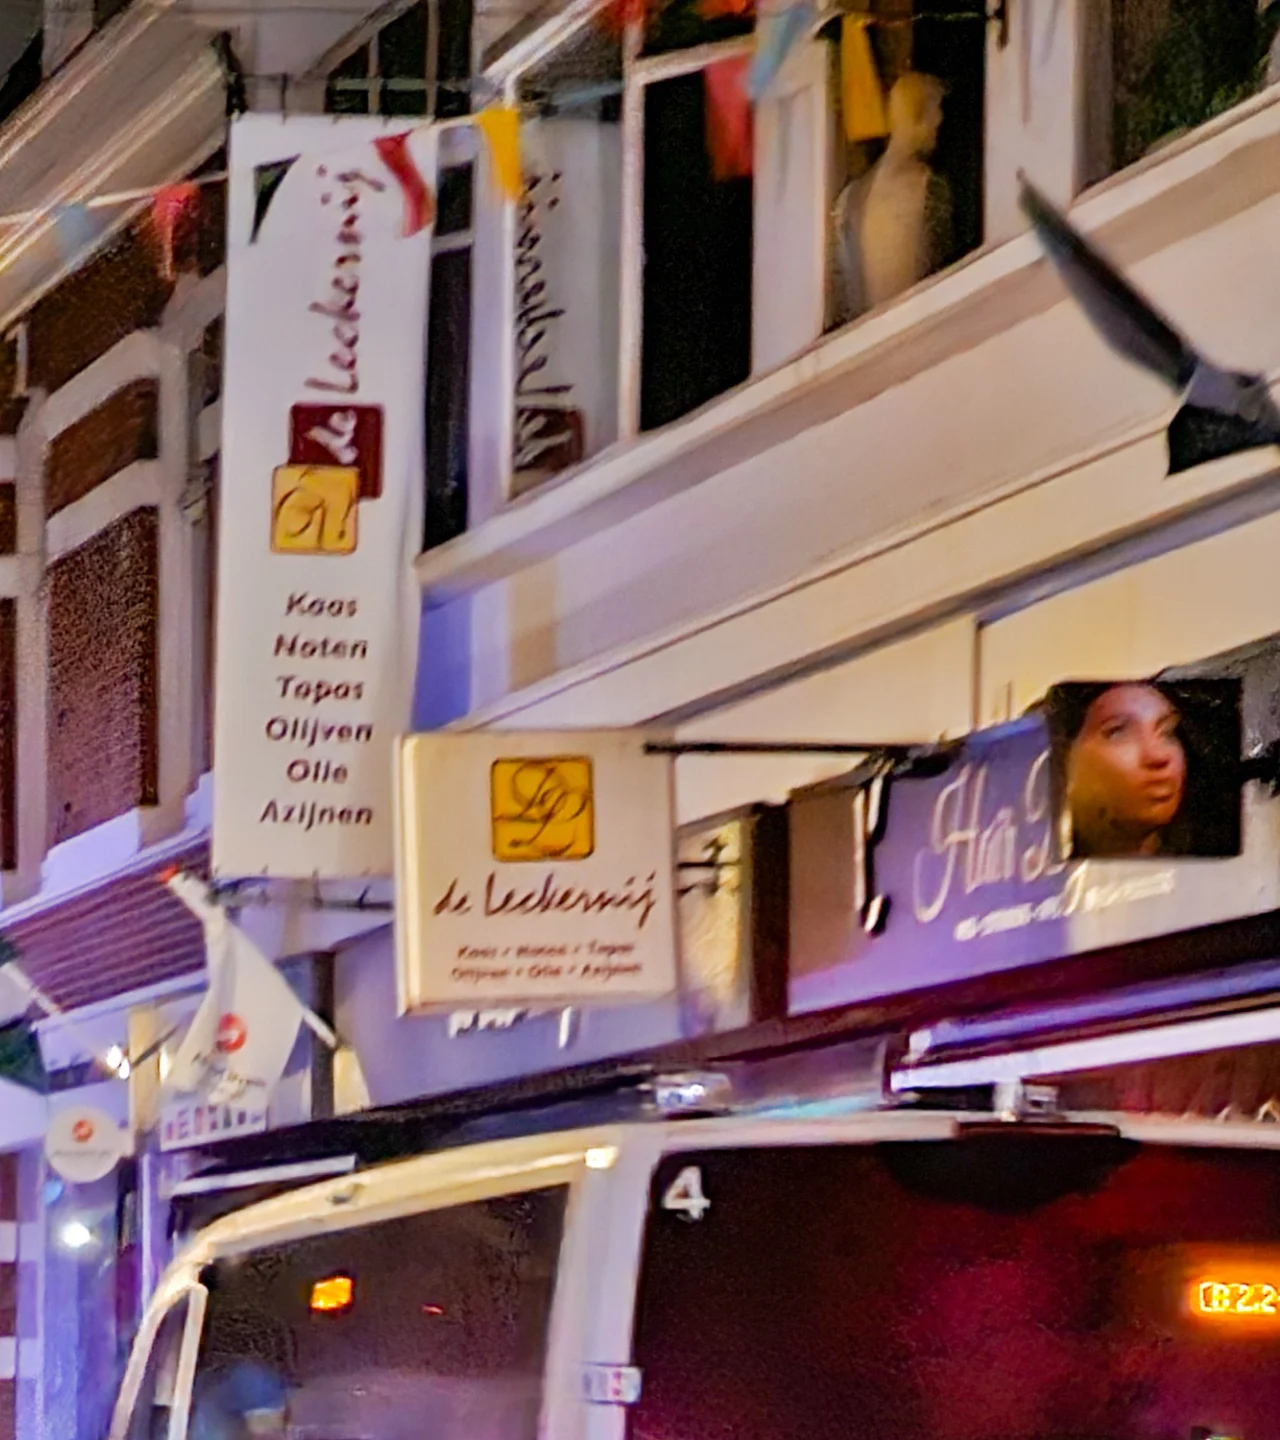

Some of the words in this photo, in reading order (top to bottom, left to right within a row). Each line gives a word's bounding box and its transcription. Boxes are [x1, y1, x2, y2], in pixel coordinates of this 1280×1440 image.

[285, 591, 357, 617] Kaas
[273, 633, 368, 659] Noten
[276, 674, 364, 706] Tapas
[265, 715, 374, 748] Olijven
[286, 758, 348, 784] Olie
[259, 798, 373, 831] Azijnen
[433, 877, 473, 916] de
[662, 1166, 711, 1220] 4
